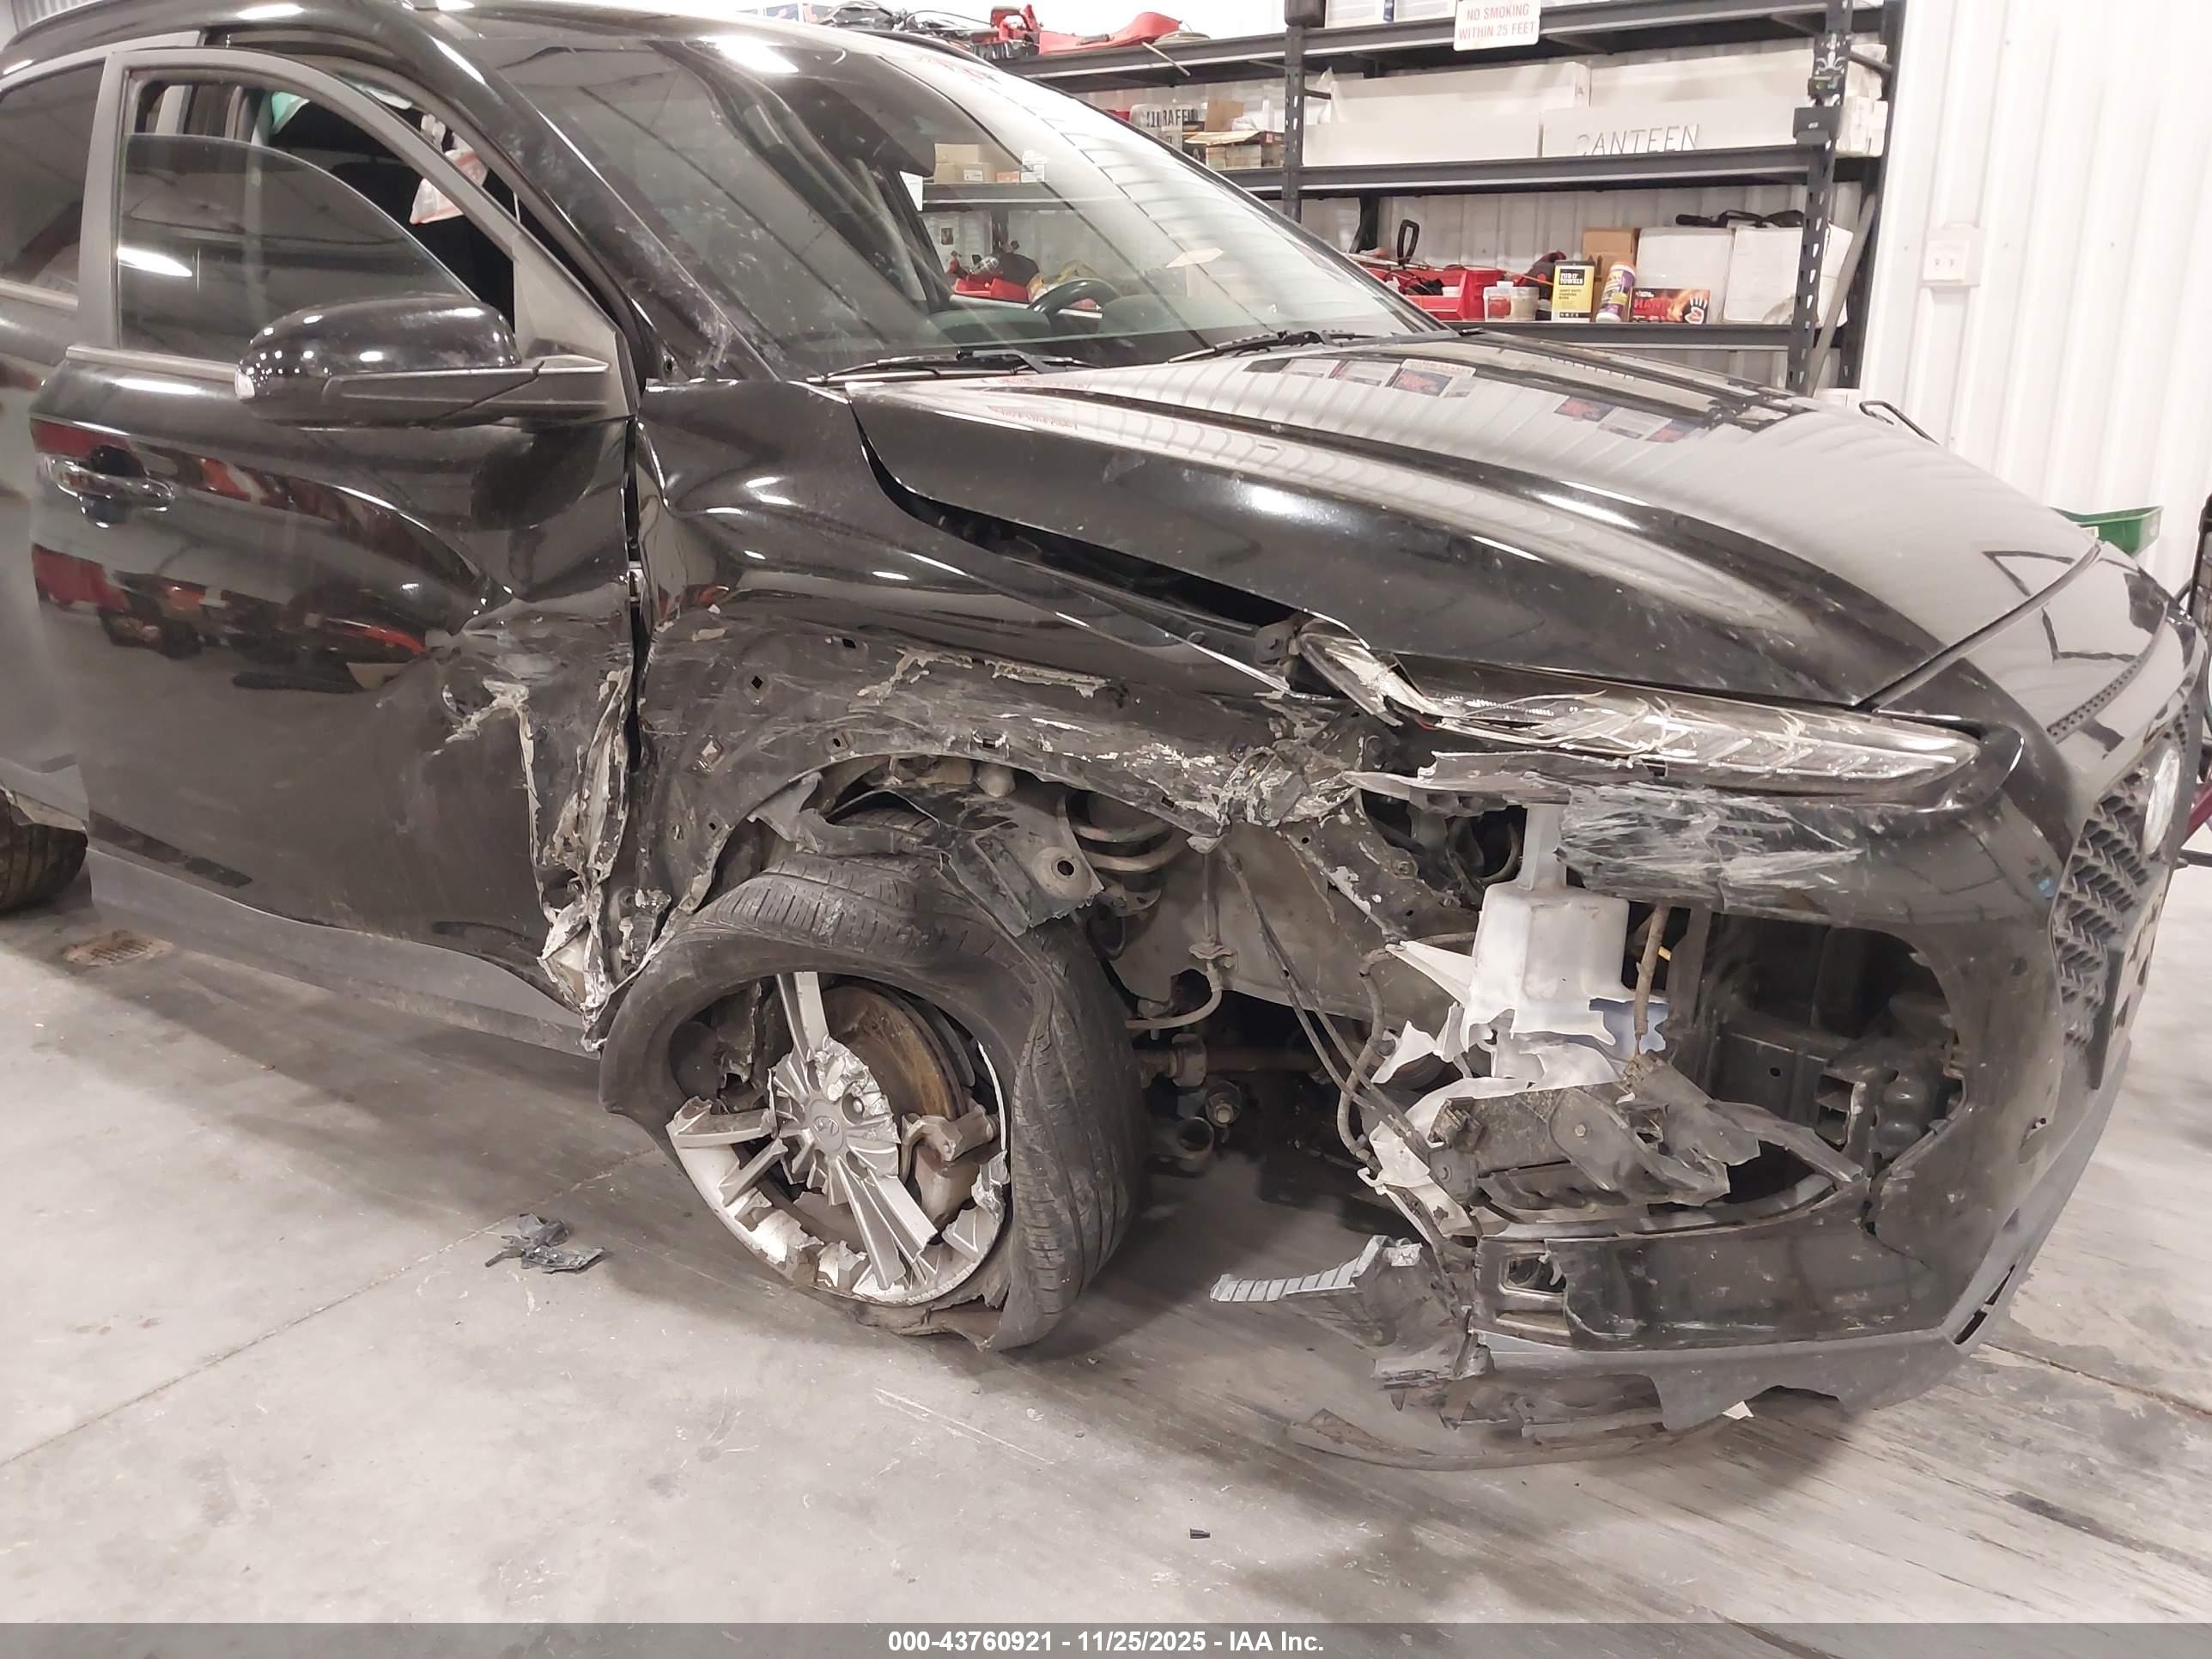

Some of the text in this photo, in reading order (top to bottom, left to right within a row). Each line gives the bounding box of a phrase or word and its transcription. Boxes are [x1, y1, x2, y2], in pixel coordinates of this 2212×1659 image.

[1467, 3, 1529, 21] NO SMOKING
[1459, 21, 1535, 40] WITHIN 25 FEET
